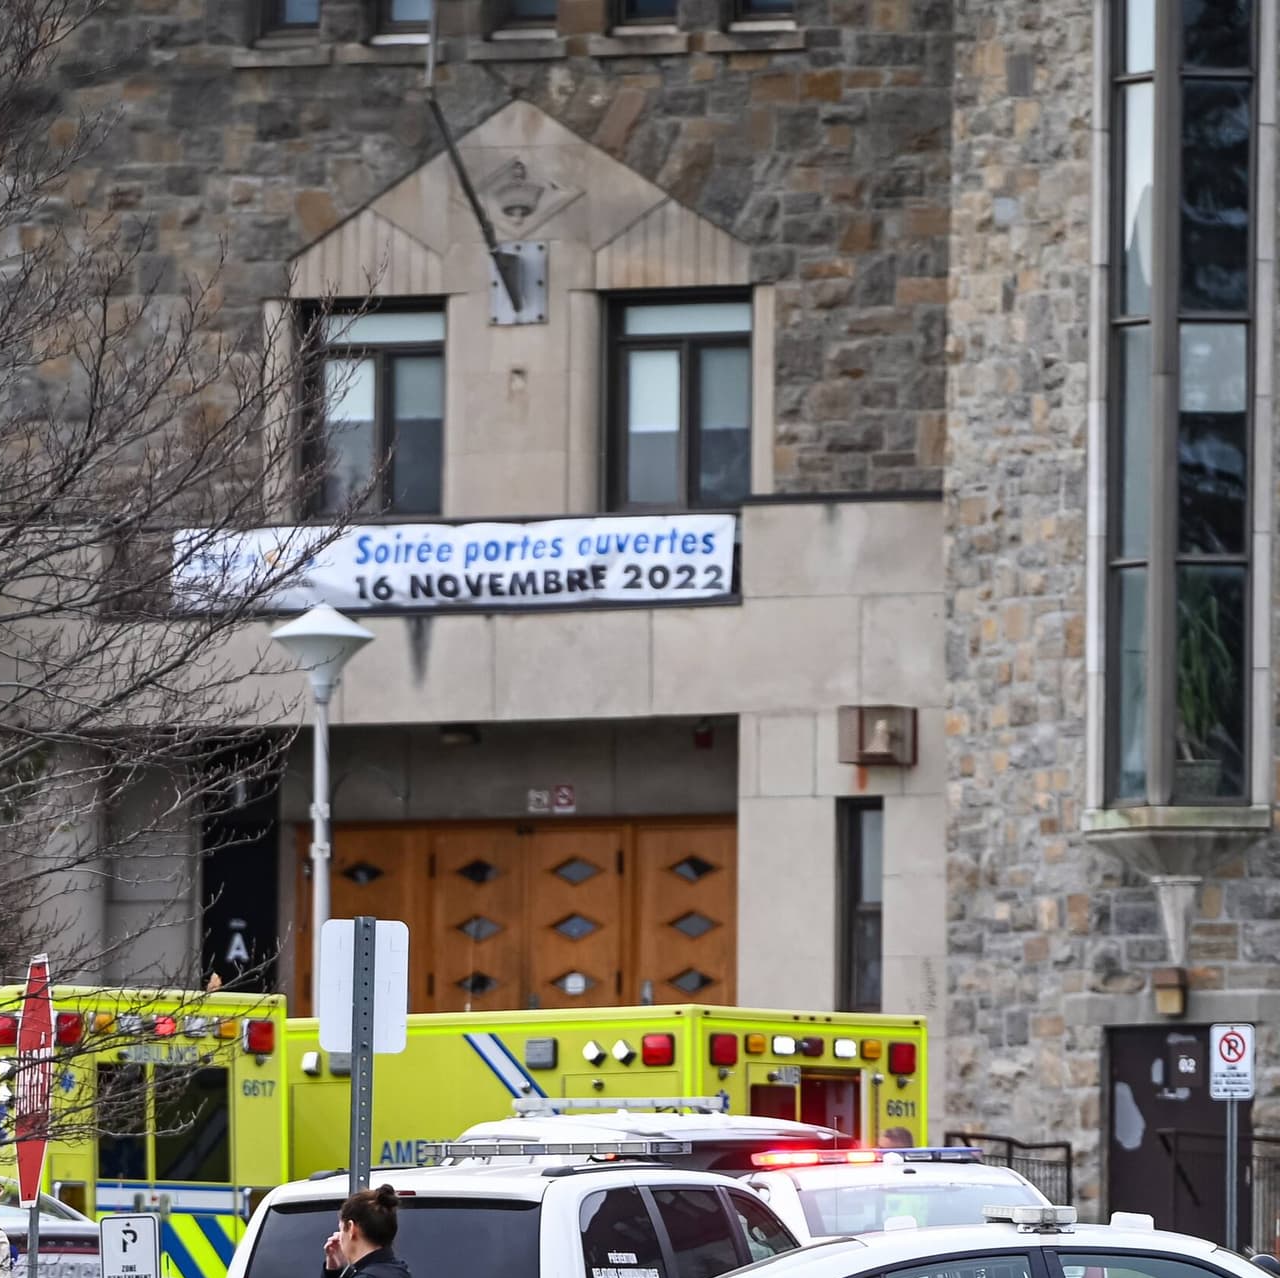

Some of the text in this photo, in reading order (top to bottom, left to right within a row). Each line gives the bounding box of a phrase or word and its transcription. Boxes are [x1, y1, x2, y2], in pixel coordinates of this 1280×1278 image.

[355, 533, 452, 565] Soirée
[464, 534, 563, 568] portes
[578, 528, 716, 558] ouvertes
[355, 563, 724, 601] 16 NOVEMBRE 2022
[228, 932, 249, 961] A
[242, 1080, 275, 1096] 6617
[887, 1100, 915, 1116] 6611
[122, 1264, 136, 1272] ZONE
